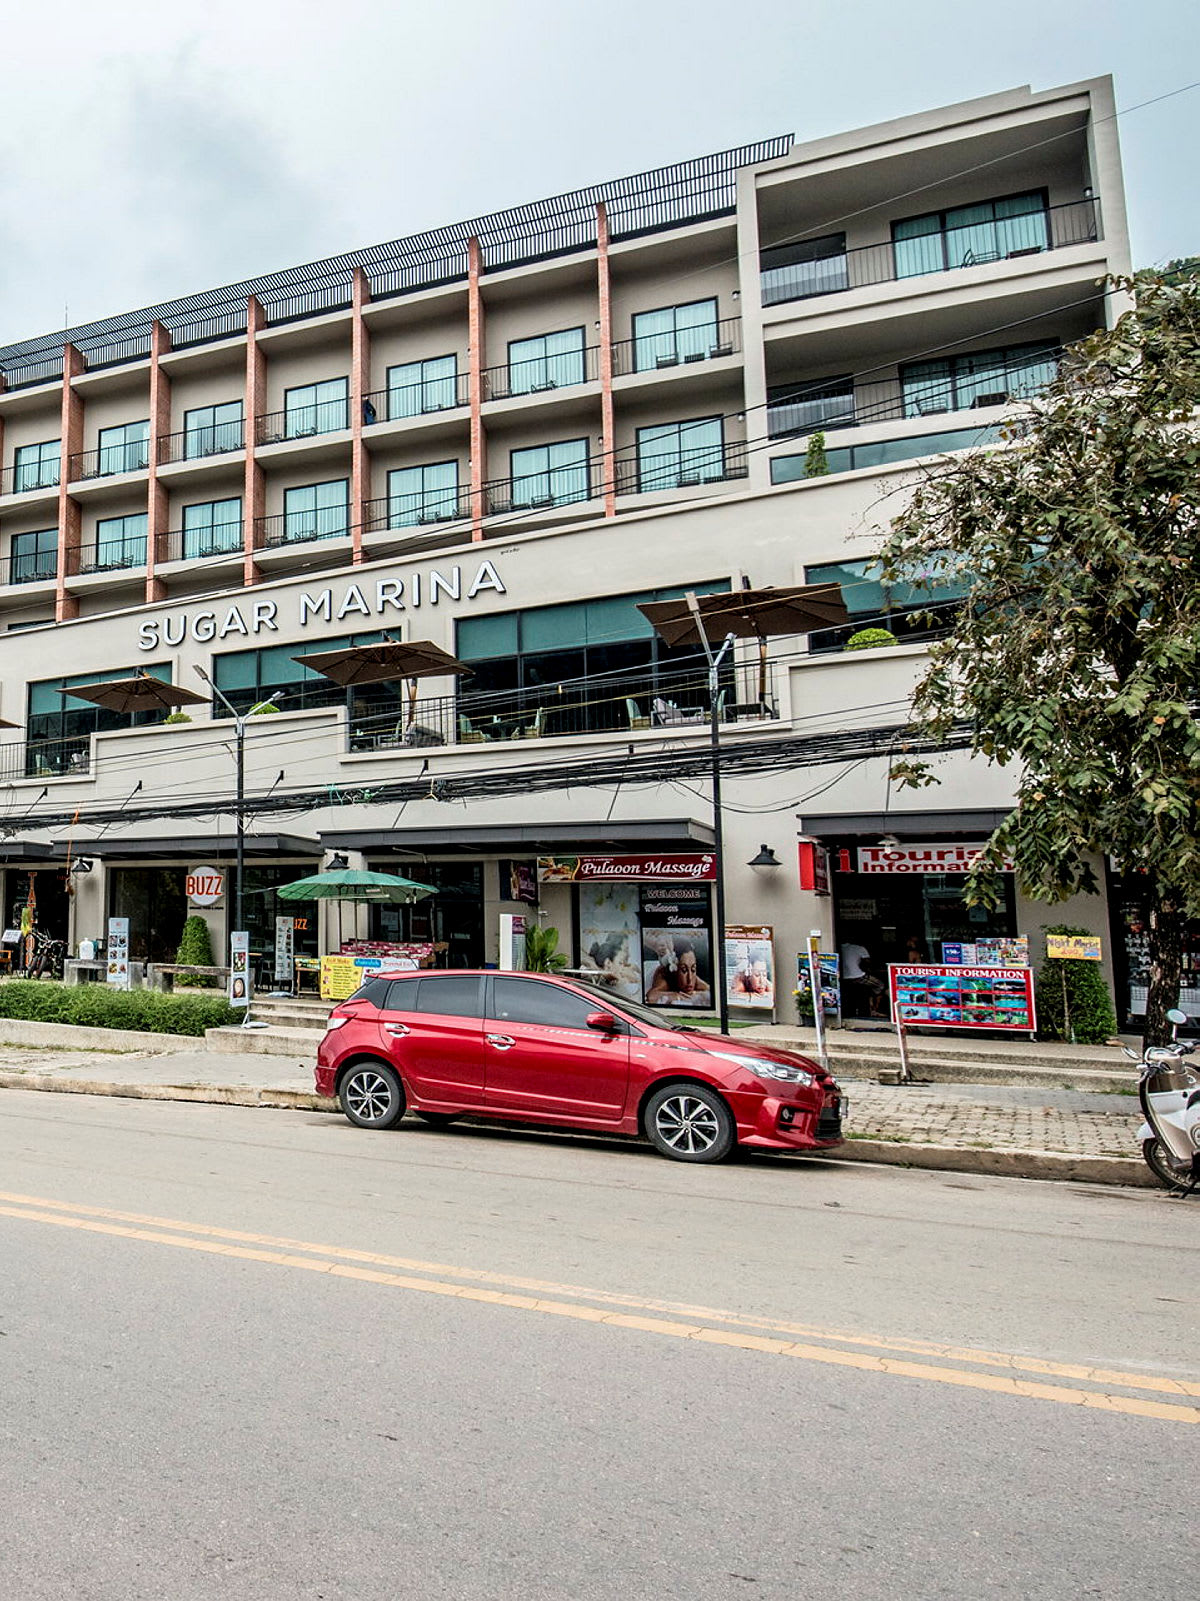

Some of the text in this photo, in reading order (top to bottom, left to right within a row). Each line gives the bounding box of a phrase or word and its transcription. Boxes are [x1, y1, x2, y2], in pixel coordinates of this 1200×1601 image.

[137, 559, 507, 651] SUGAR MARINA
[861, 846, 1008, 862] Touris
[581, 860, 711, 876] Pulaoon Massage
[862, 861, 1013, 873] Informaton
[185, 874, 224, 896] BUZZ
[647, 889, 701, 898] WELCOME
[895, 967, 1025, 979] TOURIST INFORMATION
